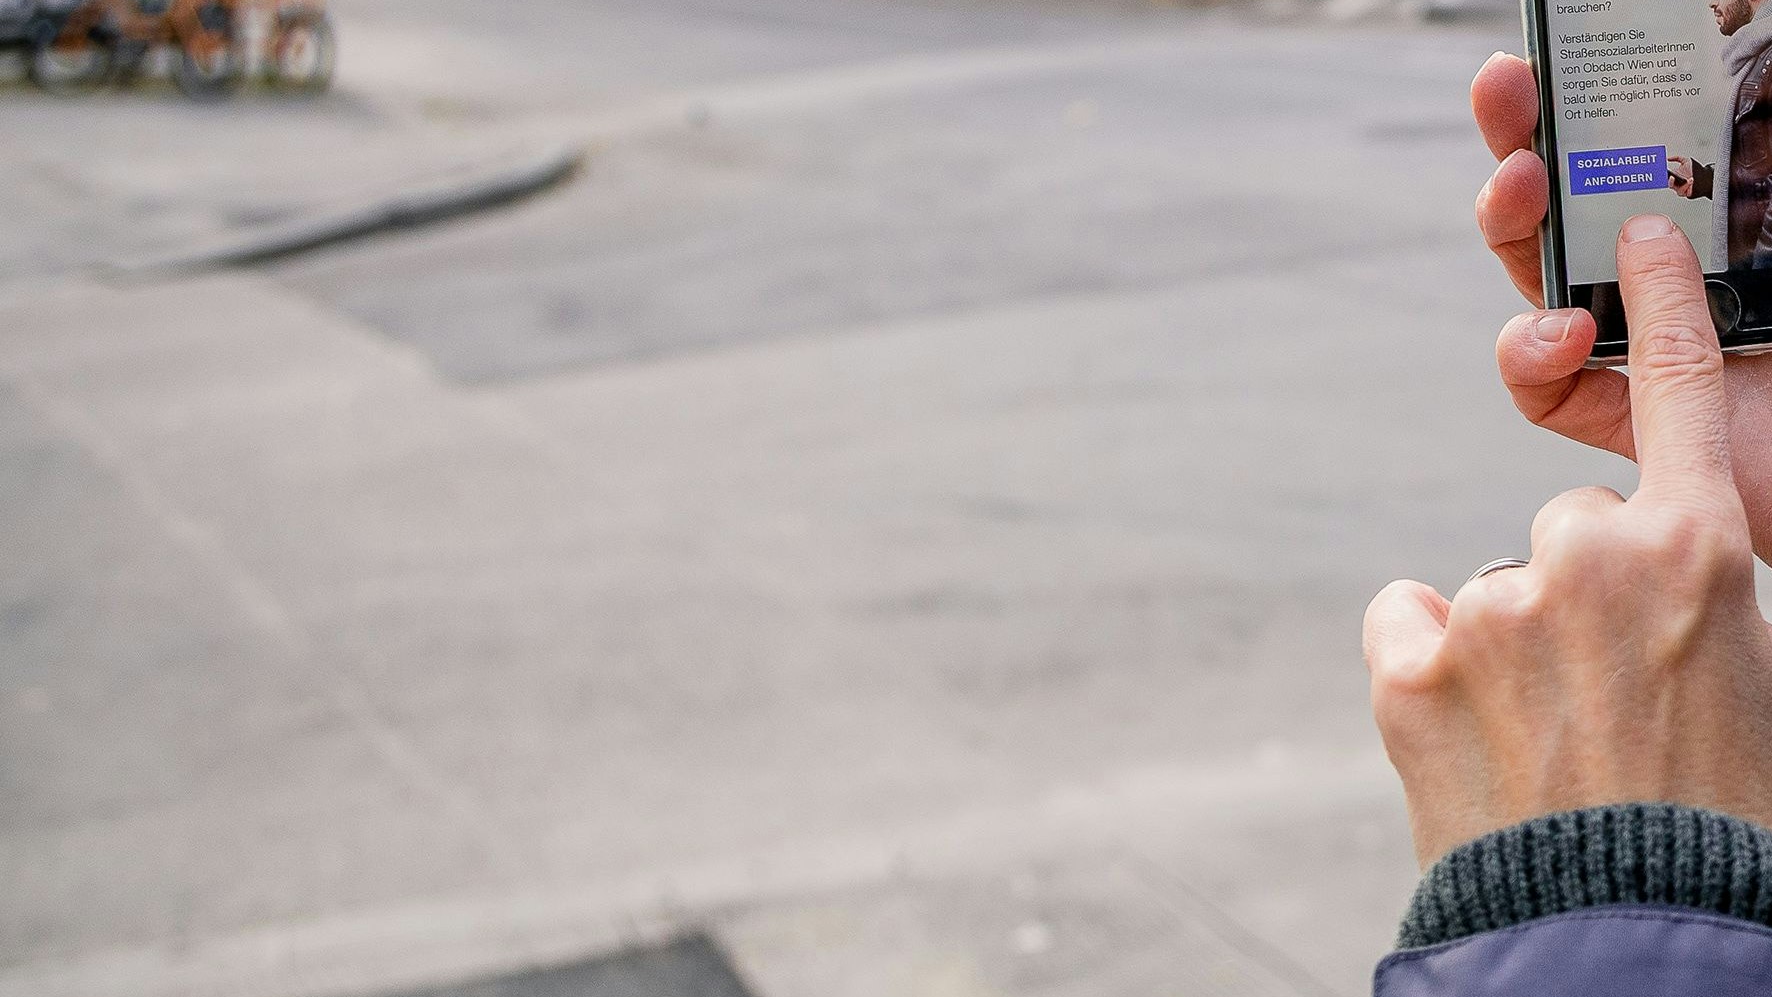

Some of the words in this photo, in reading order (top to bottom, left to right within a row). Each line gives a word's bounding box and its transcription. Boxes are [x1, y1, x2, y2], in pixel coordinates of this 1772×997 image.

[1557, 1, 1611, 14] brauchen?
[1559, 31, 1626, 43] Verständigen
[1629, 30, 1645, 40] Sie
[1561, 64, 1580, 74] von
[1583, 61, 1624, 73] Obdach
[1628, 59, 1654, 69] Wien
[1657, 58, 1676, 68] und
[1562, 78, 1598, 91] sorgen
[1602, 76, 1618, 86] Sie
[1621, 74, 1649, 86] dafür,
[1652, 73, 1677, 83] dass
[1680, 73, 1692, 81] so
[1564, 93, 1587, 104] bald
[1590, 92, 1607, 103] wie
[1610, 89, 1650, 102] möglich
[1654, 87, 1681, 98] Profis
[1685, 87, 1700, 96] vor
[1565, 109, 1581, 119] Ort
[1584, 107, 1618, 118] helfen.
[1577, 154, 1657, 169] SOZIALARBEIT
[1584, 173, 1653, 186] ANFORDERN
